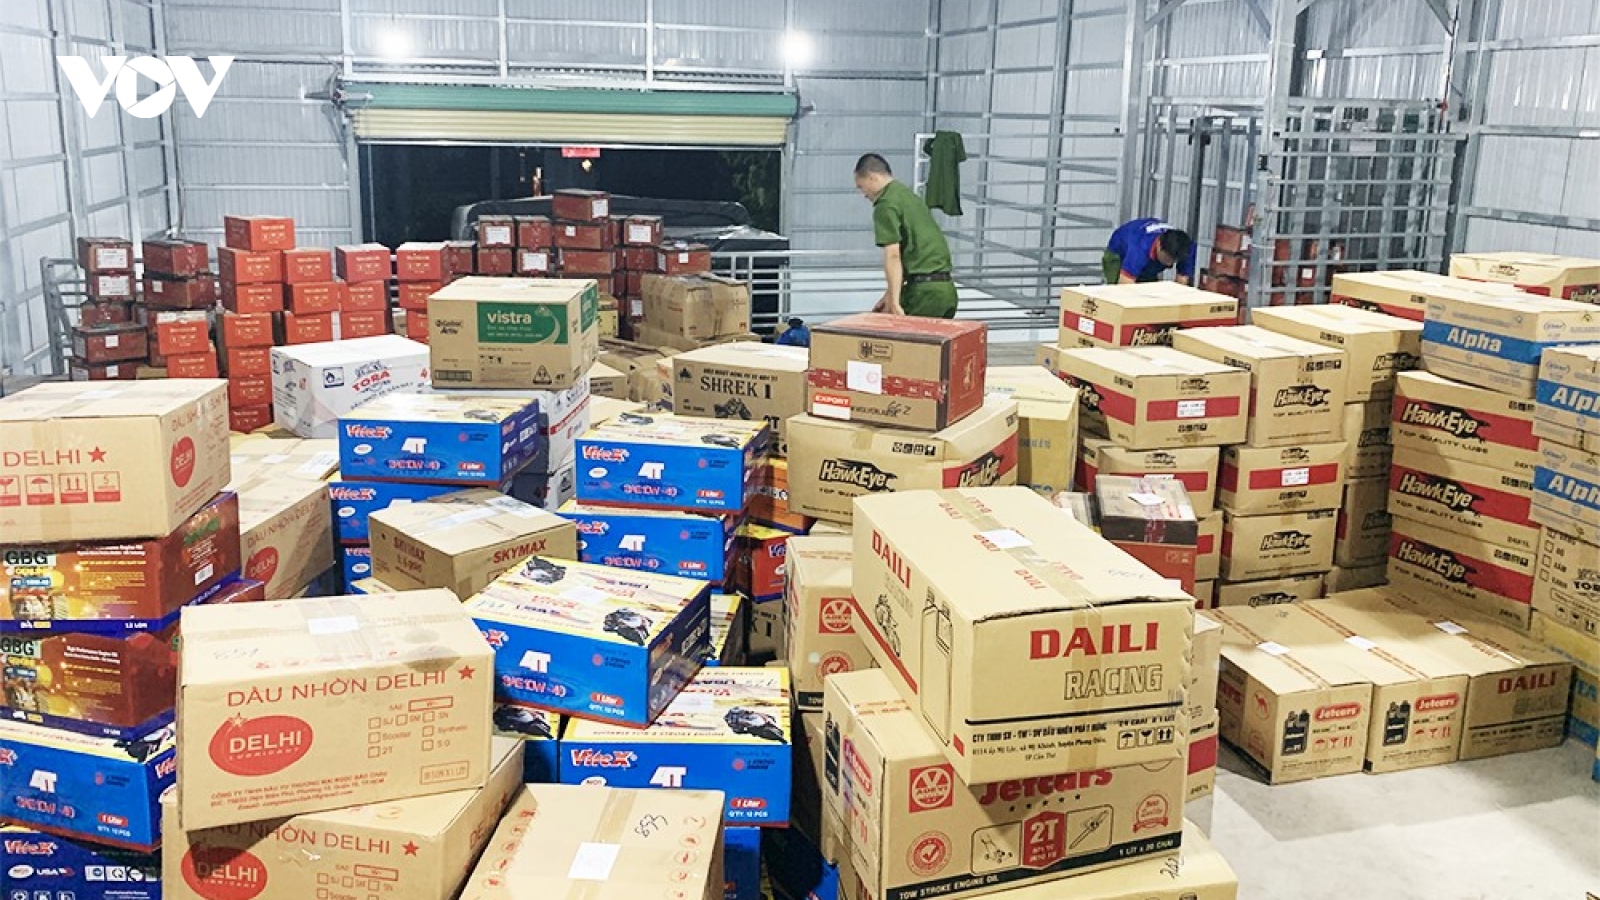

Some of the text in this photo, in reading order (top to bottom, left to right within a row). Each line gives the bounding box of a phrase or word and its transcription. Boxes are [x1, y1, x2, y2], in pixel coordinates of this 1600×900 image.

[487, 310, 532, 324] vistra
[1447, 327, 1501, 352] Alpha
[352, 370, 391, 391] TORA
[700, 375, 758, 397] SHREK
[763, 415, 779, 430] T
[1402, 402, 1478, 435] HawkEye
[401, 437, 427, 454] 4T
[1419, 433, 1459, 447] QUALITY
[3, 449, 80, 467] DELHI
[638, 462, 665, 479] 4T
[819, 460, 887, 489] HawkEye
[1400, 473, 1473, 508] HawkEye
[493, 539, 547, 565] SKYMAX
[618, 535, 646, 551] 4T
[5, 550, 49, 565] GBG
[871, 529, 912, 589] DAILI
[1397, 541, 1466, 579] HawkEye
[0, 638, 34, 656] GBG
[1029, 622, 1159, 660] DAILI
[519, 650, 550, 673] 4T
[376, 670, 446, 691] DELHI
[1064, 663, 1163, 700] RACING
[1498, 671, 1557, 694] DAILI
[230, 731, 302, 754] DELHI
[29, 769, 57, 793] 4T
[650, 766, 686, 787] 4T
[980, 768, 1112, 806] Jetcars
[1030, 818, 1058, 844] 2T
[325, 832, 390, 854] DELHI
[198, 864, 257, 882] DELHI
[920, 883, 951, 897] STROKE
[954, 877, 984, 890] ENGINE
[987, 874, 998, 884] OIL
